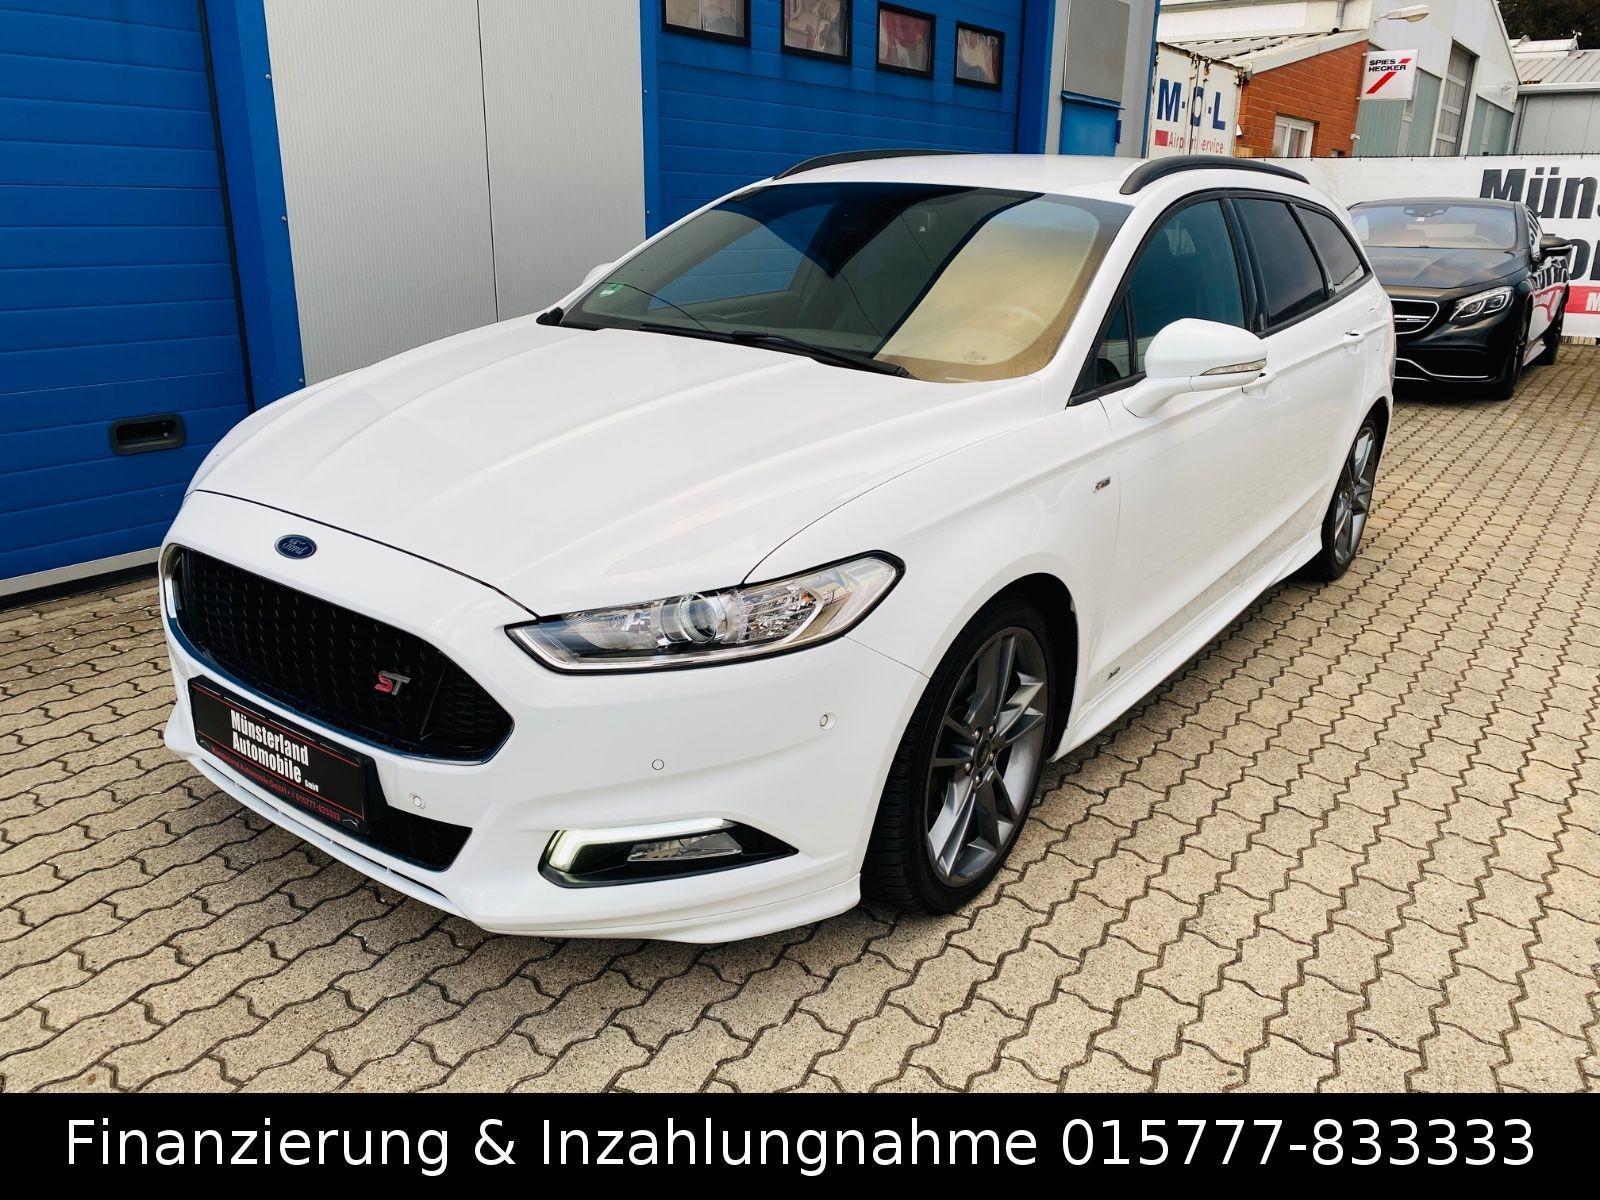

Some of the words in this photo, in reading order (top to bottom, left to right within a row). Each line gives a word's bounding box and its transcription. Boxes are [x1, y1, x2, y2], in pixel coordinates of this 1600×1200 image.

[1368, 64, 1407, 72] HECKER
[1369, 58, 1396, 66] SPIES
[1200, 137, 1224, 154] ervice
[1480, 166, 1600, 219] Mün
[374, 670, 411, 696] ST
[230, 709, 309, 767] Münsterland
[232, 730, 302, 784] Automobile
